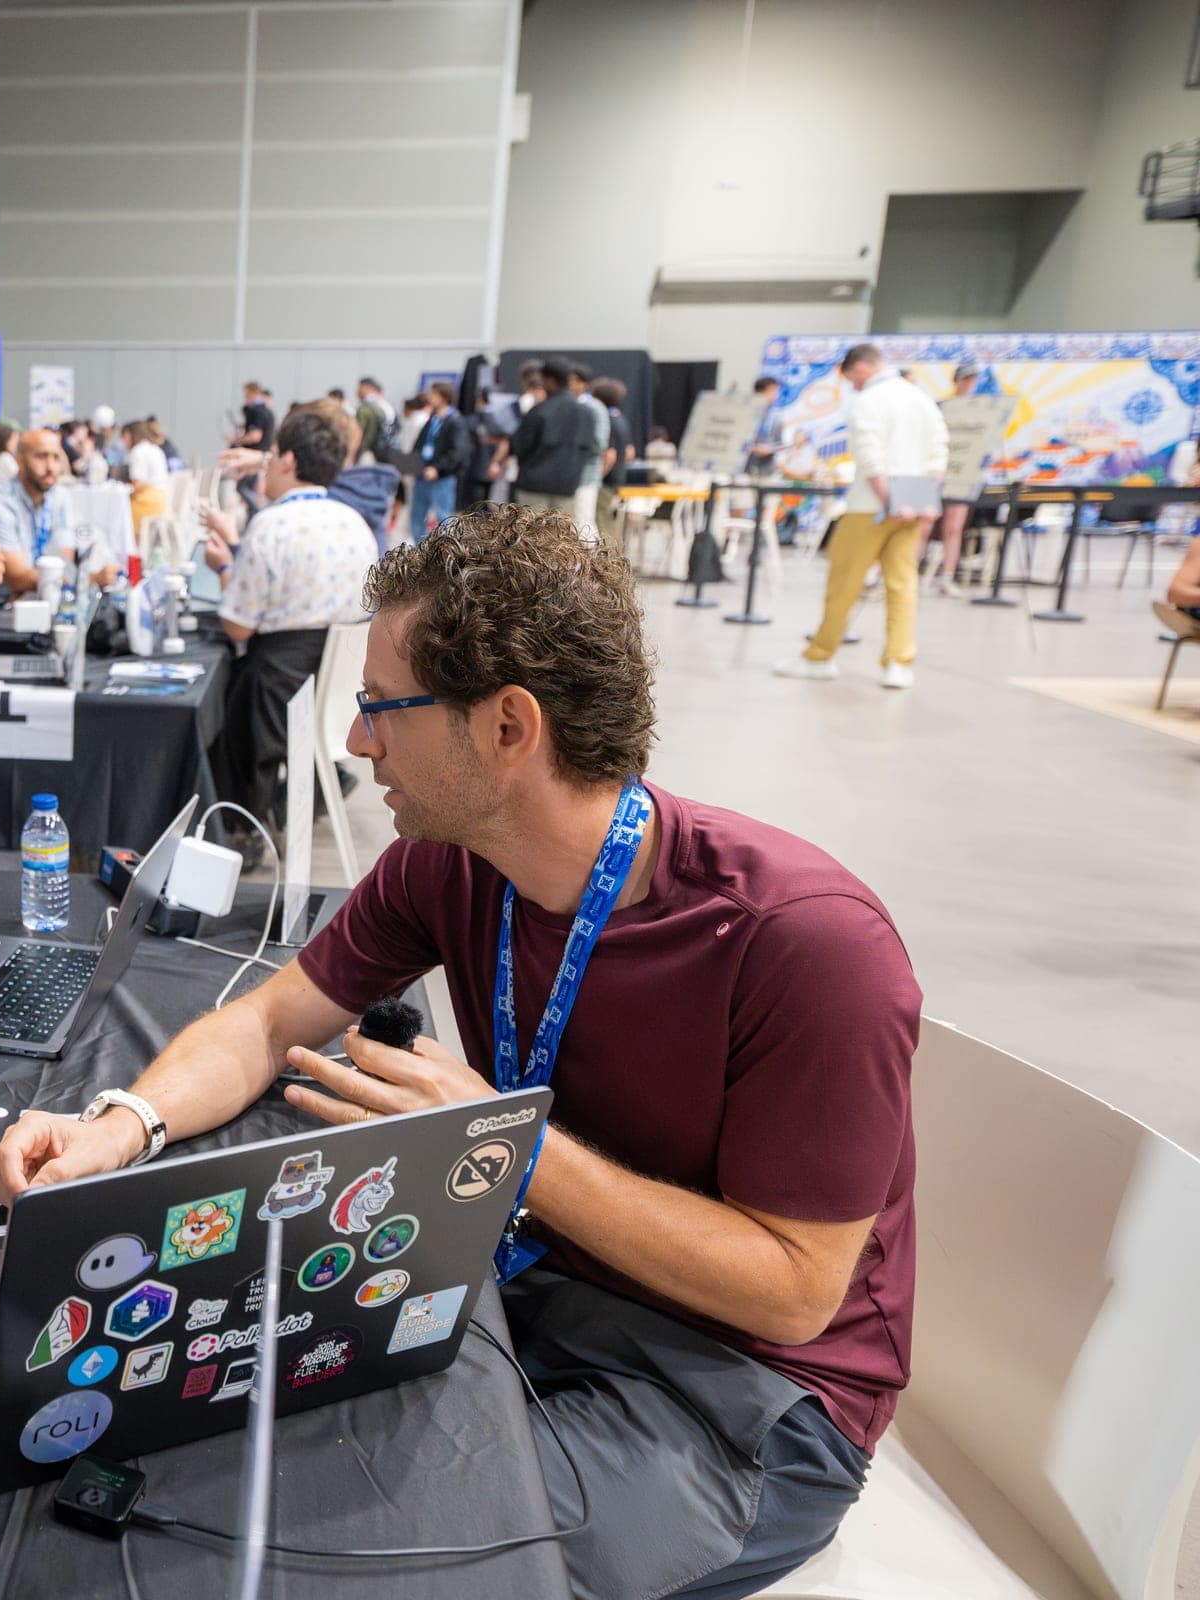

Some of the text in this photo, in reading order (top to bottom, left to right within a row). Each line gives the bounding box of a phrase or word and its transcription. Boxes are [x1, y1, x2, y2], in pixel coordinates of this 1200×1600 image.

[485, 1111, 534, 1129] Polkadot
[188, 1312, 219, 1328] Cloud
[395, 1318, 452, 1342] EUROPE
[291, 1365, 345, 1389] BUILDERS
[294, 1355, 348, 1379] FUEL FOR
